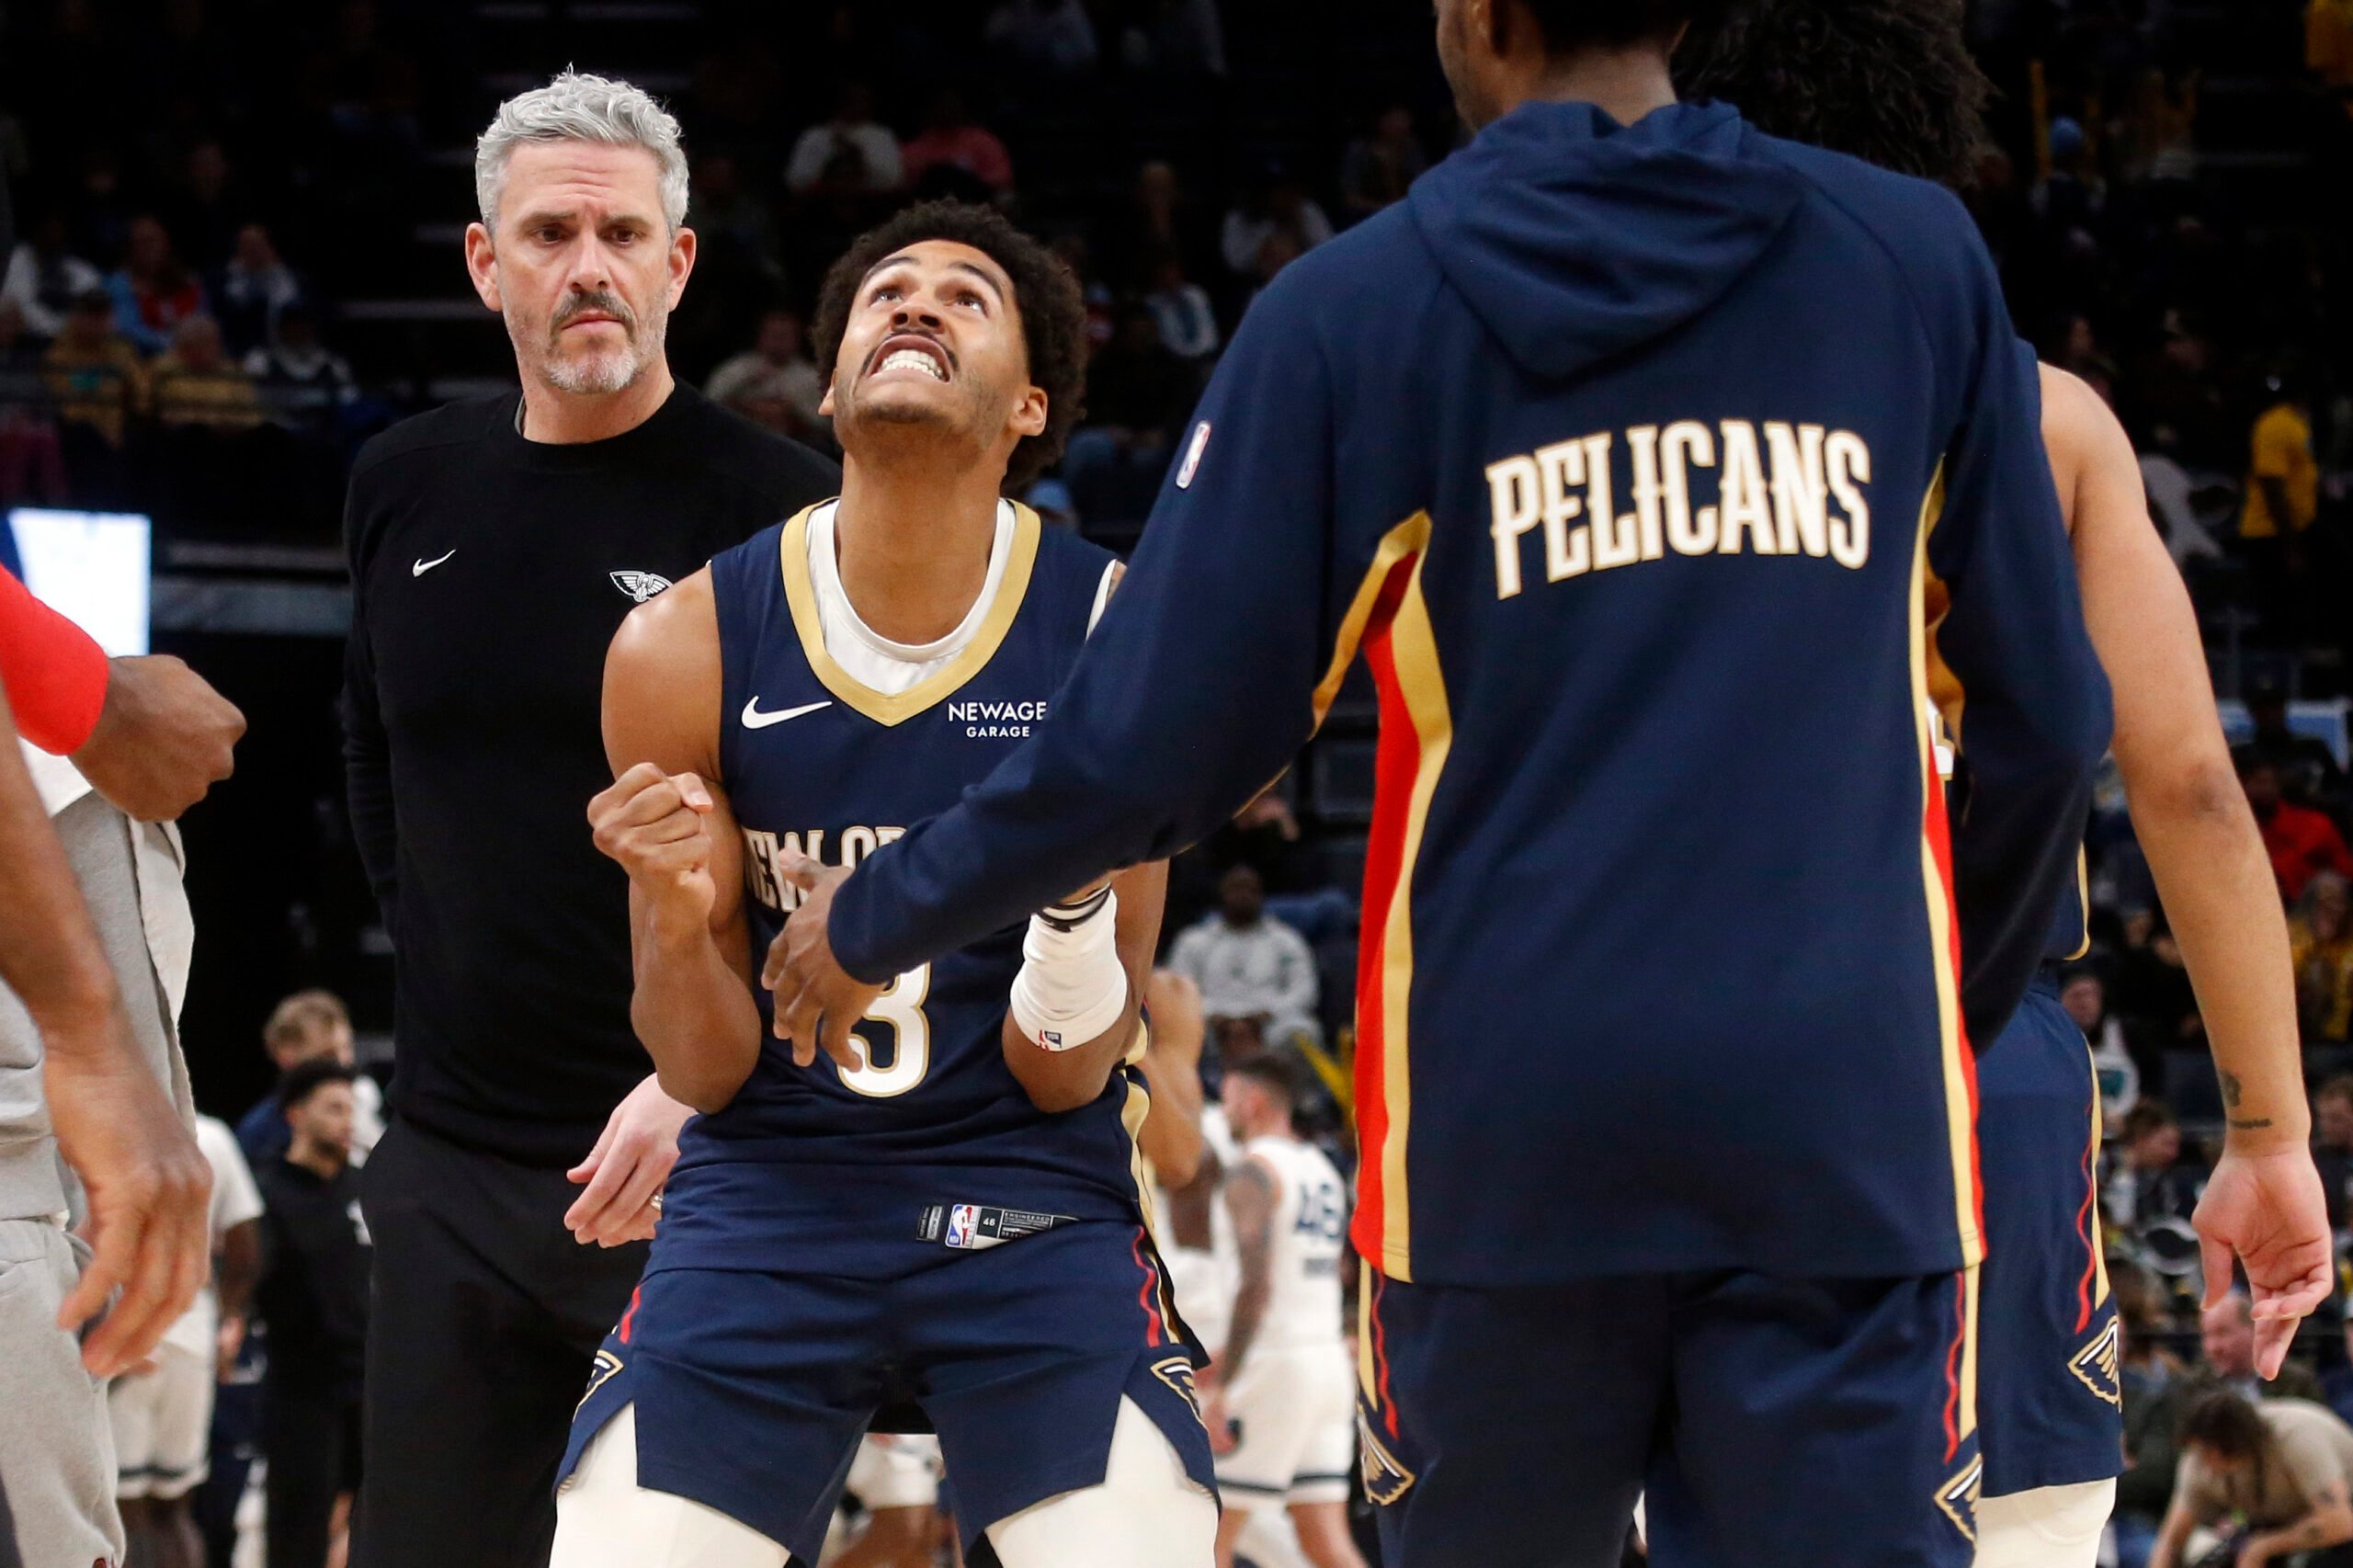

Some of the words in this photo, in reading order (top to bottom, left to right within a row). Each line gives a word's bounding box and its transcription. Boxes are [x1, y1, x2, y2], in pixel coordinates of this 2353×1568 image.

[1484, 418, 1871, 600] PELICANS
[948, 701, 1047, 722] NEWAGE
[966, 726, 1030, 738] GARAGE
[837, 961, 932, 1098] 3
